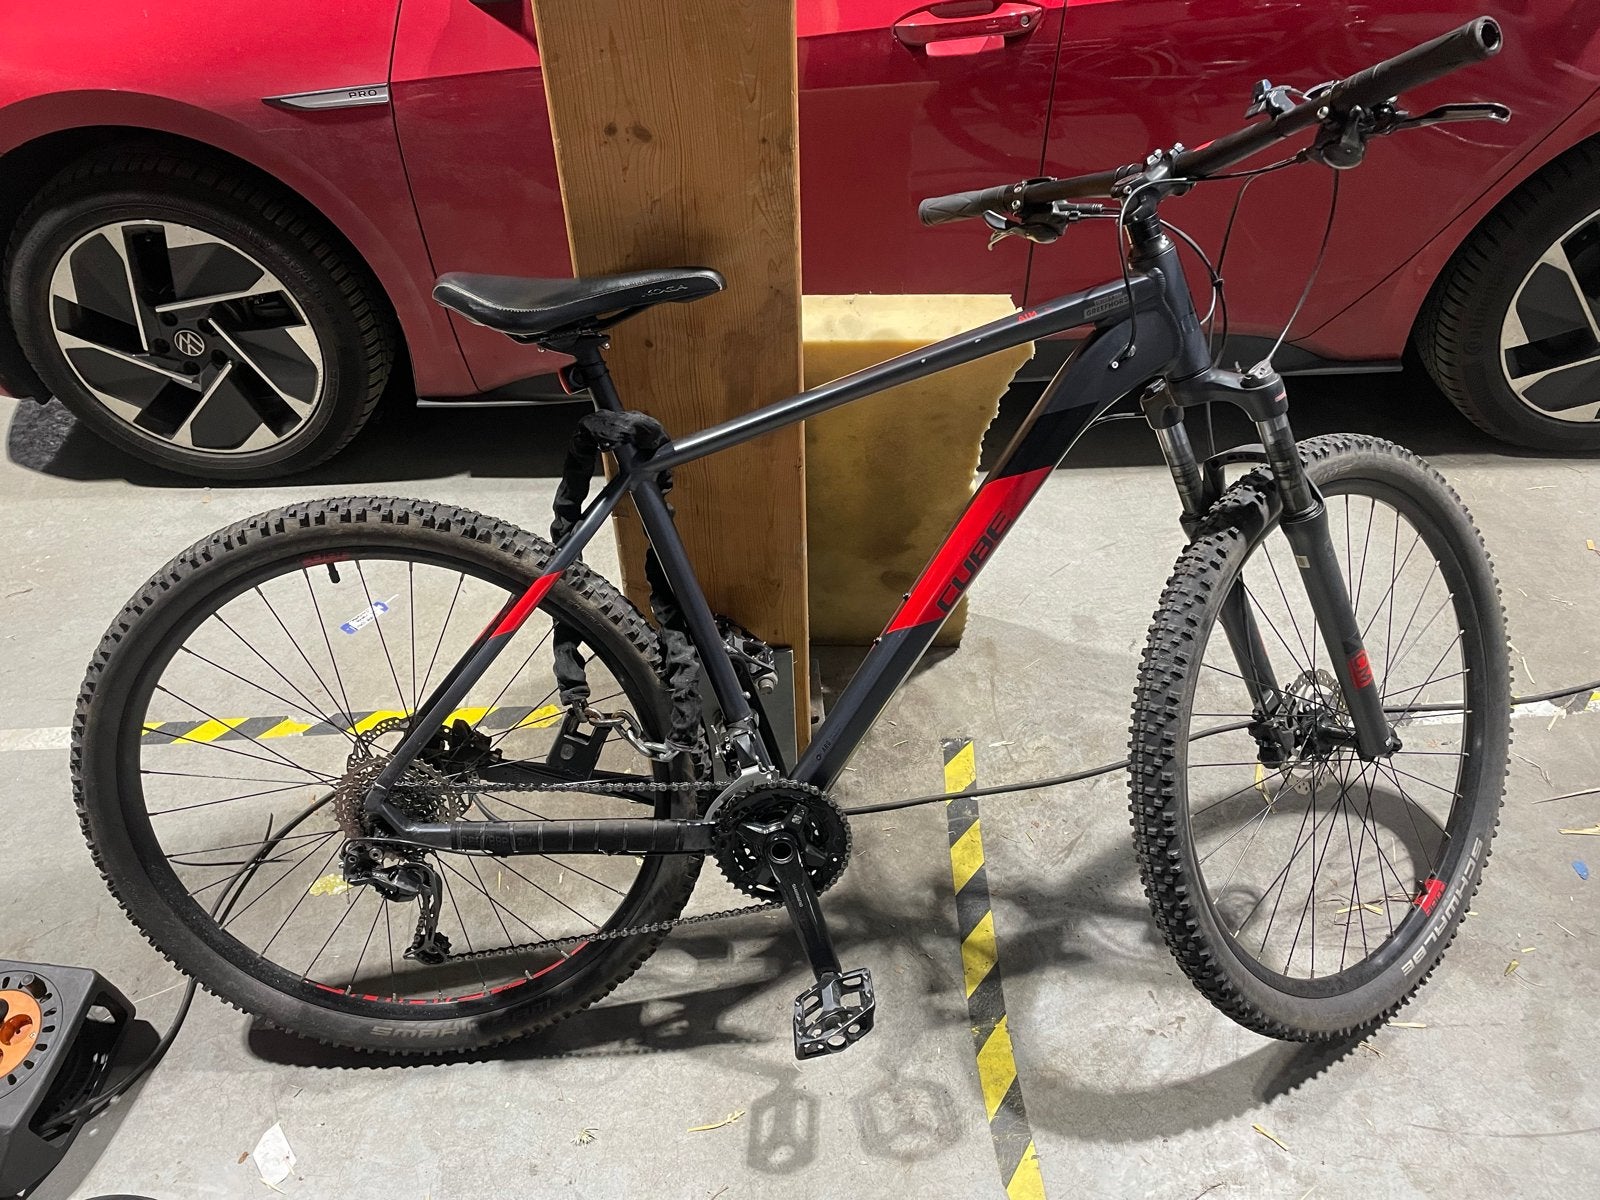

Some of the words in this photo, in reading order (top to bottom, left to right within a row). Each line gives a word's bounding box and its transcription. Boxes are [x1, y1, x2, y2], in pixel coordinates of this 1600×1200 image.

[349, 90, 377, 98] PRO
[1086, 296, 1131, 317] GREEFHORS
[936, 510, 1011, 613] CUBE
[1401, 837, 1484, 977] SCHWALBE
